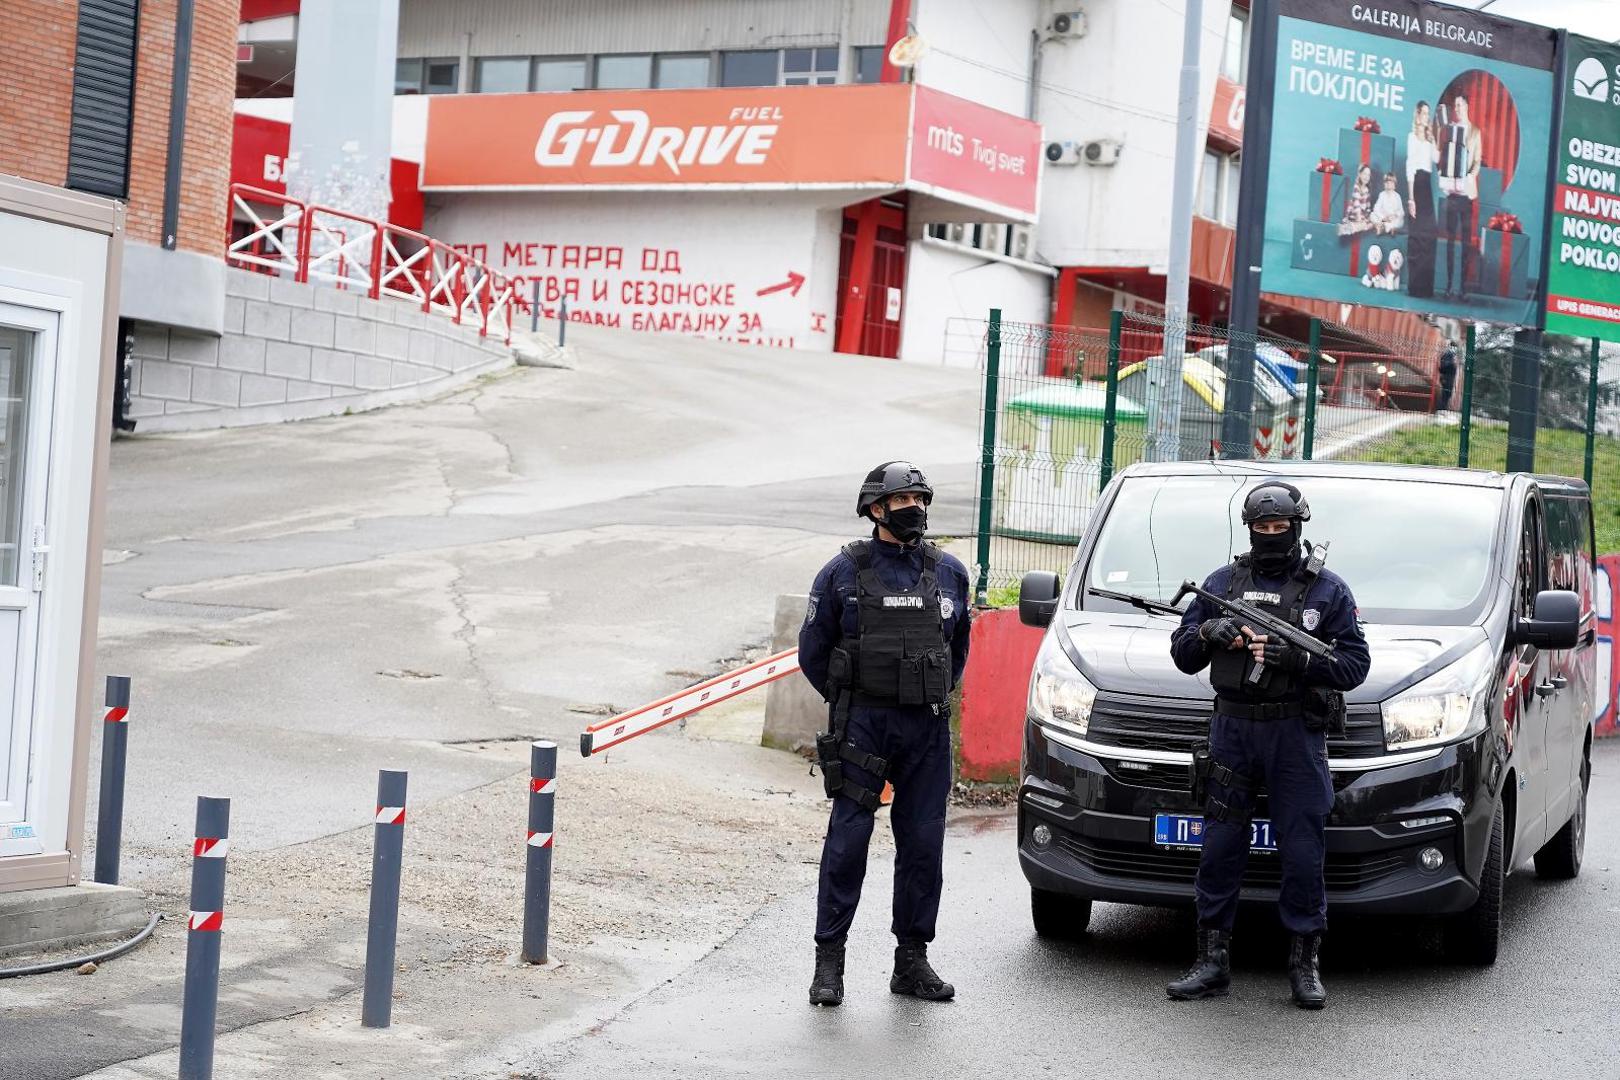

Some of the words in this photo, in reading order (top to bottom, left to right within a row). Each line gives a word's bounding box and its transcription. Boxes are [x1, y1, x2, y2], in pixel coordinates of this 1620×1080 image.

[1352, 5, 1421, 35] GALERIJA
[1425, 20, 1493, 48] BELGRADE
[1290, 38, 1355, 71] ВРЕМЕ
[1357, 52, 1378, 75] ЈЕ
[1380, 57, 1405, 80] ЗА
[1289, 64, 1405, 111] ПОКЛОНЕ
[729, 106, 784, 121] FUEL
[927, 125, 964, 156] mts
[971, 138, 998, 172] Tvoj
[998, 152, 1026, 175] svet
[1566, 163, 1616, 192] SVOM
[1564, 190, 1620, 220] NAJVR
[1562, 216, 1620, 247] NOVOG
[503, 241, 624, 271] МЕТАРА
[641, 246, 681, 275] ОД
[1560, 242, 1620, 273] POKLO
[592, 279, 609, 303] И
[621, 279, 735, 307] СЕЗОНСКЕ
[1556, 298, 1578, 314] UPIS
[632, 311, 730, 333] БЛАГАЈНУ
[737, 312, 763, 334] ЗА
[1177, 819, 1189, 842] П
